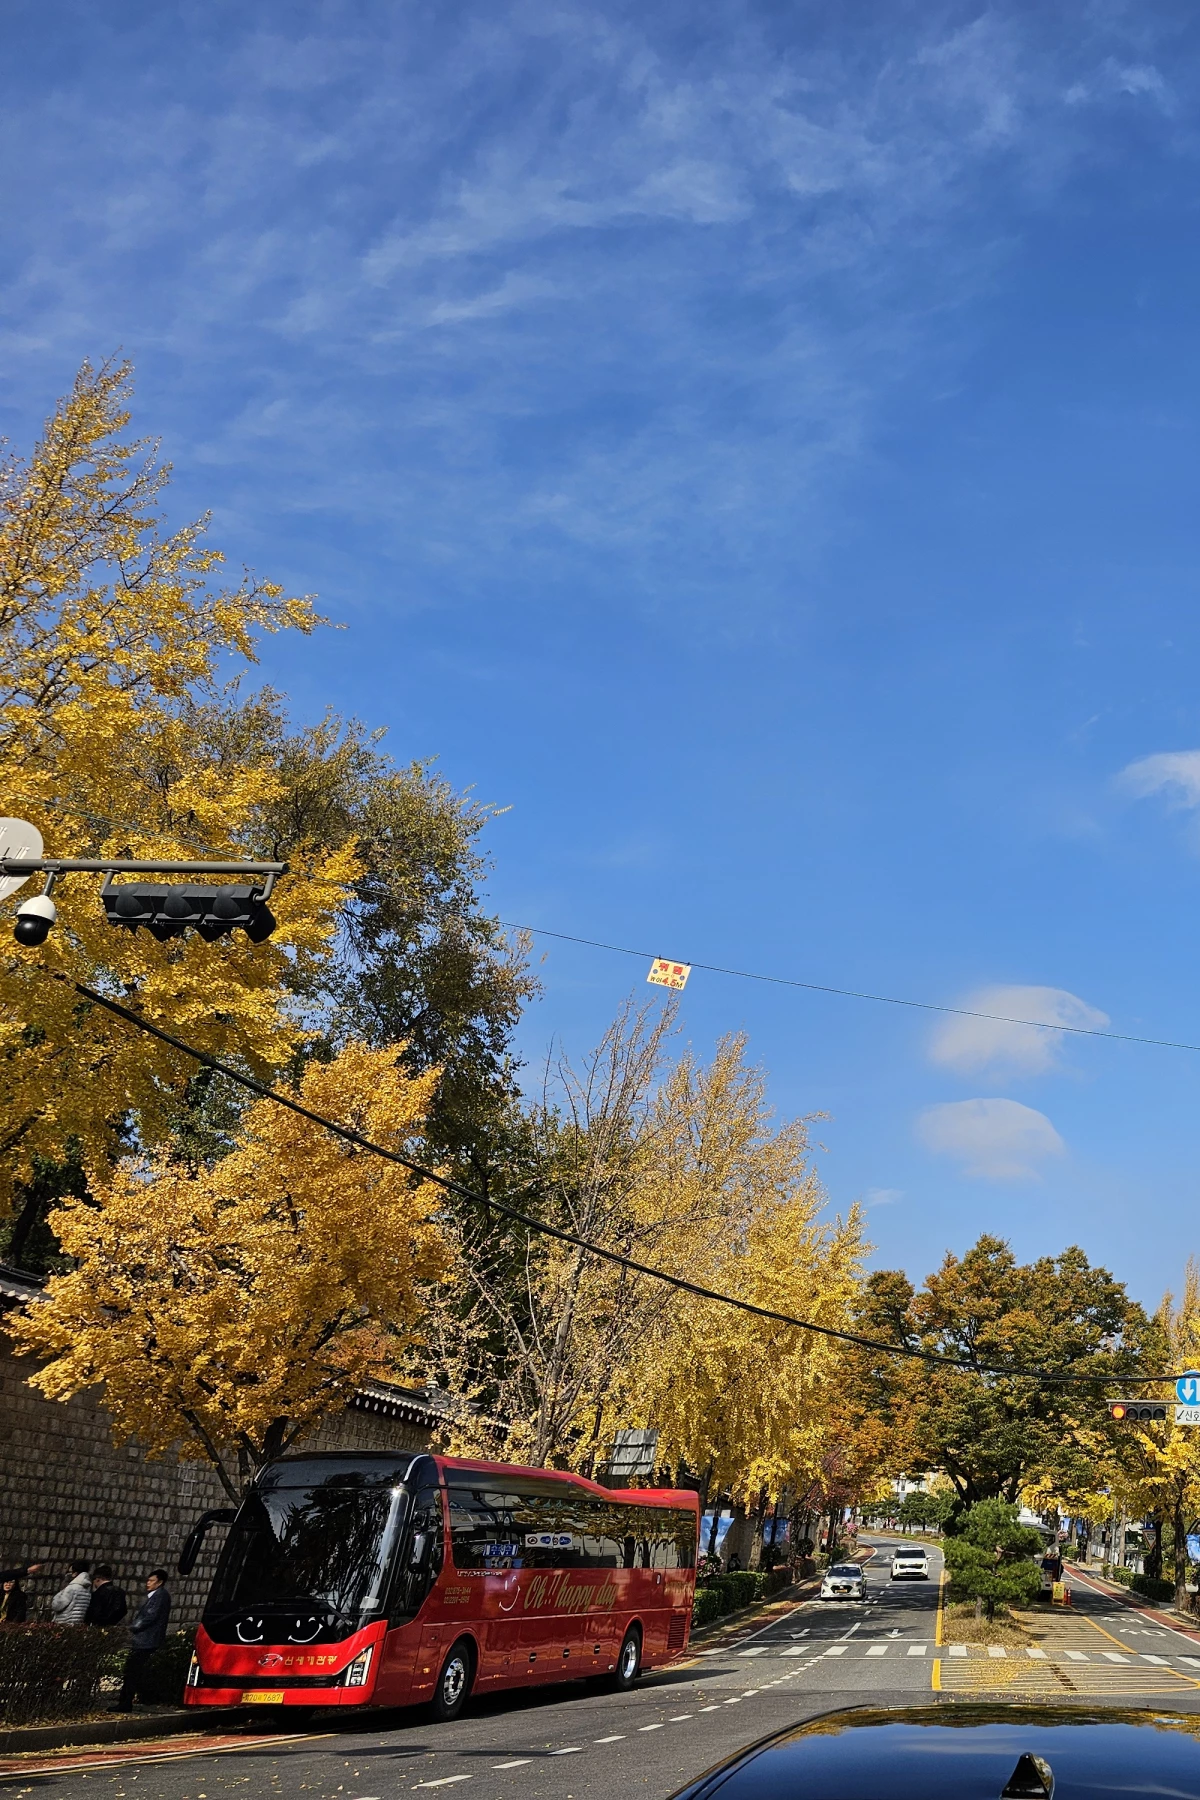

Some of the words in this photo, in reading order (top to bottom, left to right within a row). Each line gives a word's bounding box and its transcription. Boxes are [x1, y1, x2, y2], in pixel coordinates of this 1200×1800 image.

[554, 1573, 595, 1614] happy
[594, 1572, 619, 1612] day
[284, 1655, 338, 1666] 신세계관광
